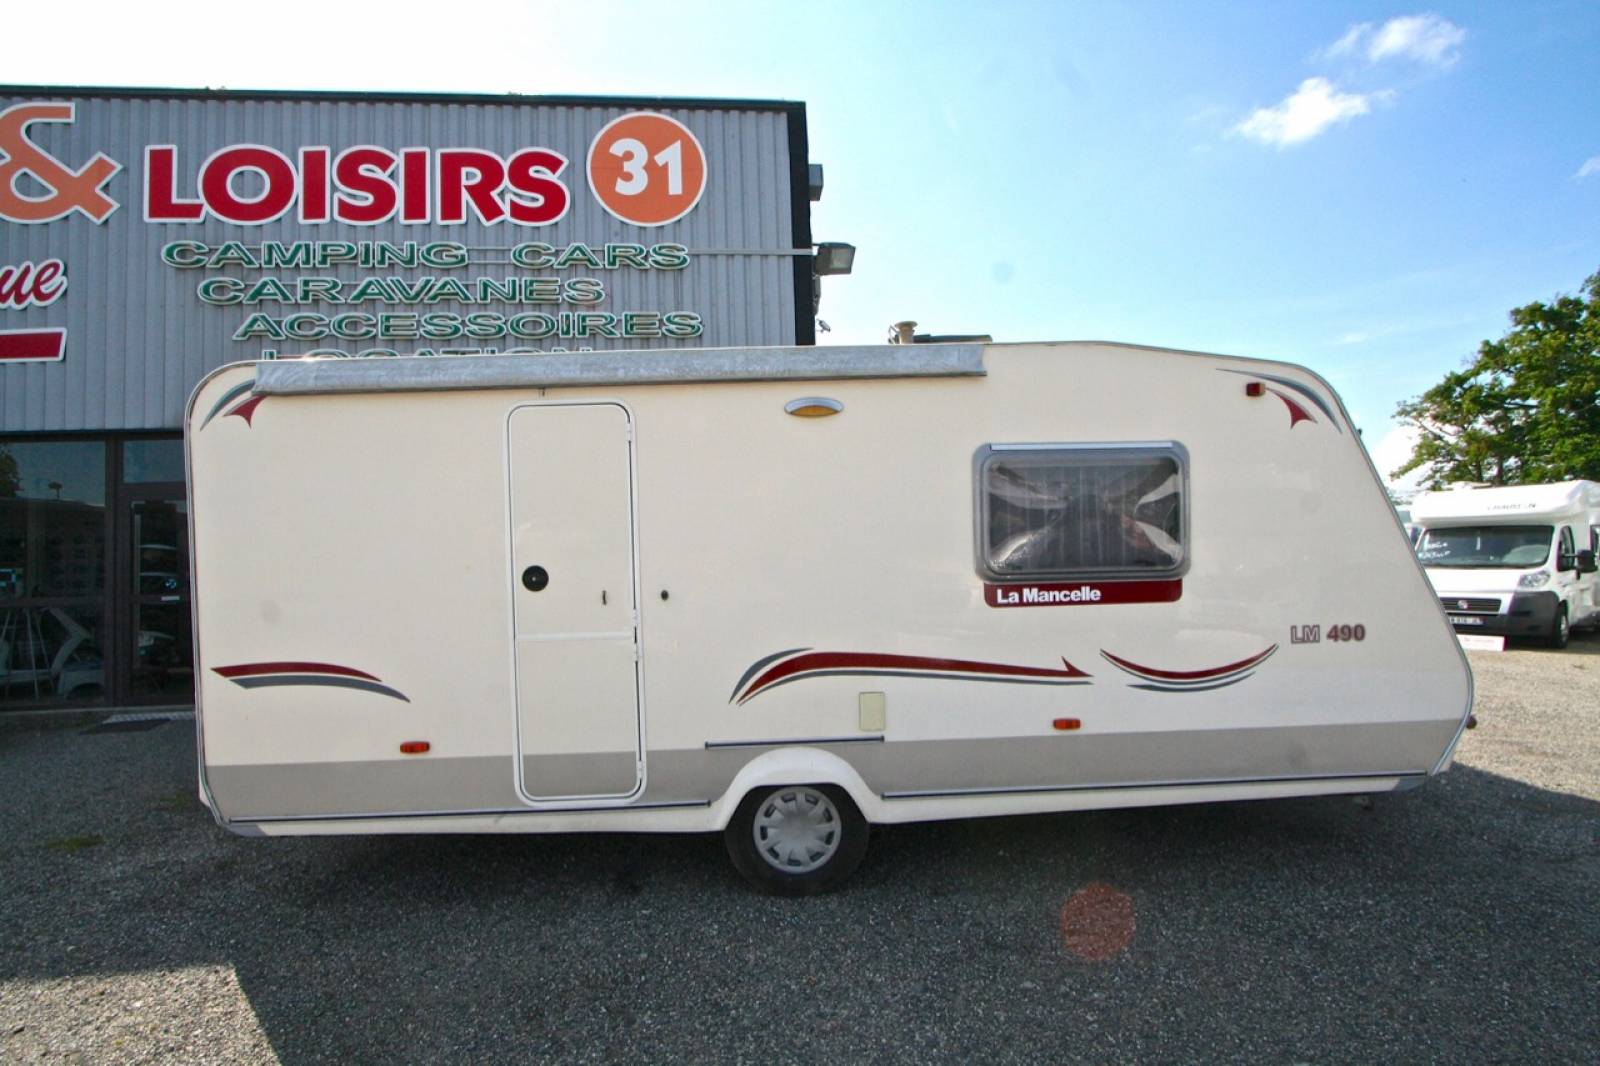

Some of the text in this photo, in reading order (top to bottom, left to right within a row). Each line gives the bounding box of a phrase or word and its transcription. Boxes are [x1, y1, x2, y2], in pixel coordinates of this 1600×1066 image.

[145, 145, 570, 226] LOISIRS
[609, 137, 684, 196] 31
[161, 240, 691, 270] CAMPING CARS
[197, 276, 606, 305] CARAVANES
[232, 311, 704, 342] ACCESSOIRES
[997, 585, 1102, 604] La Mancelle
[1290, 623, 1366, 644] LM 490
